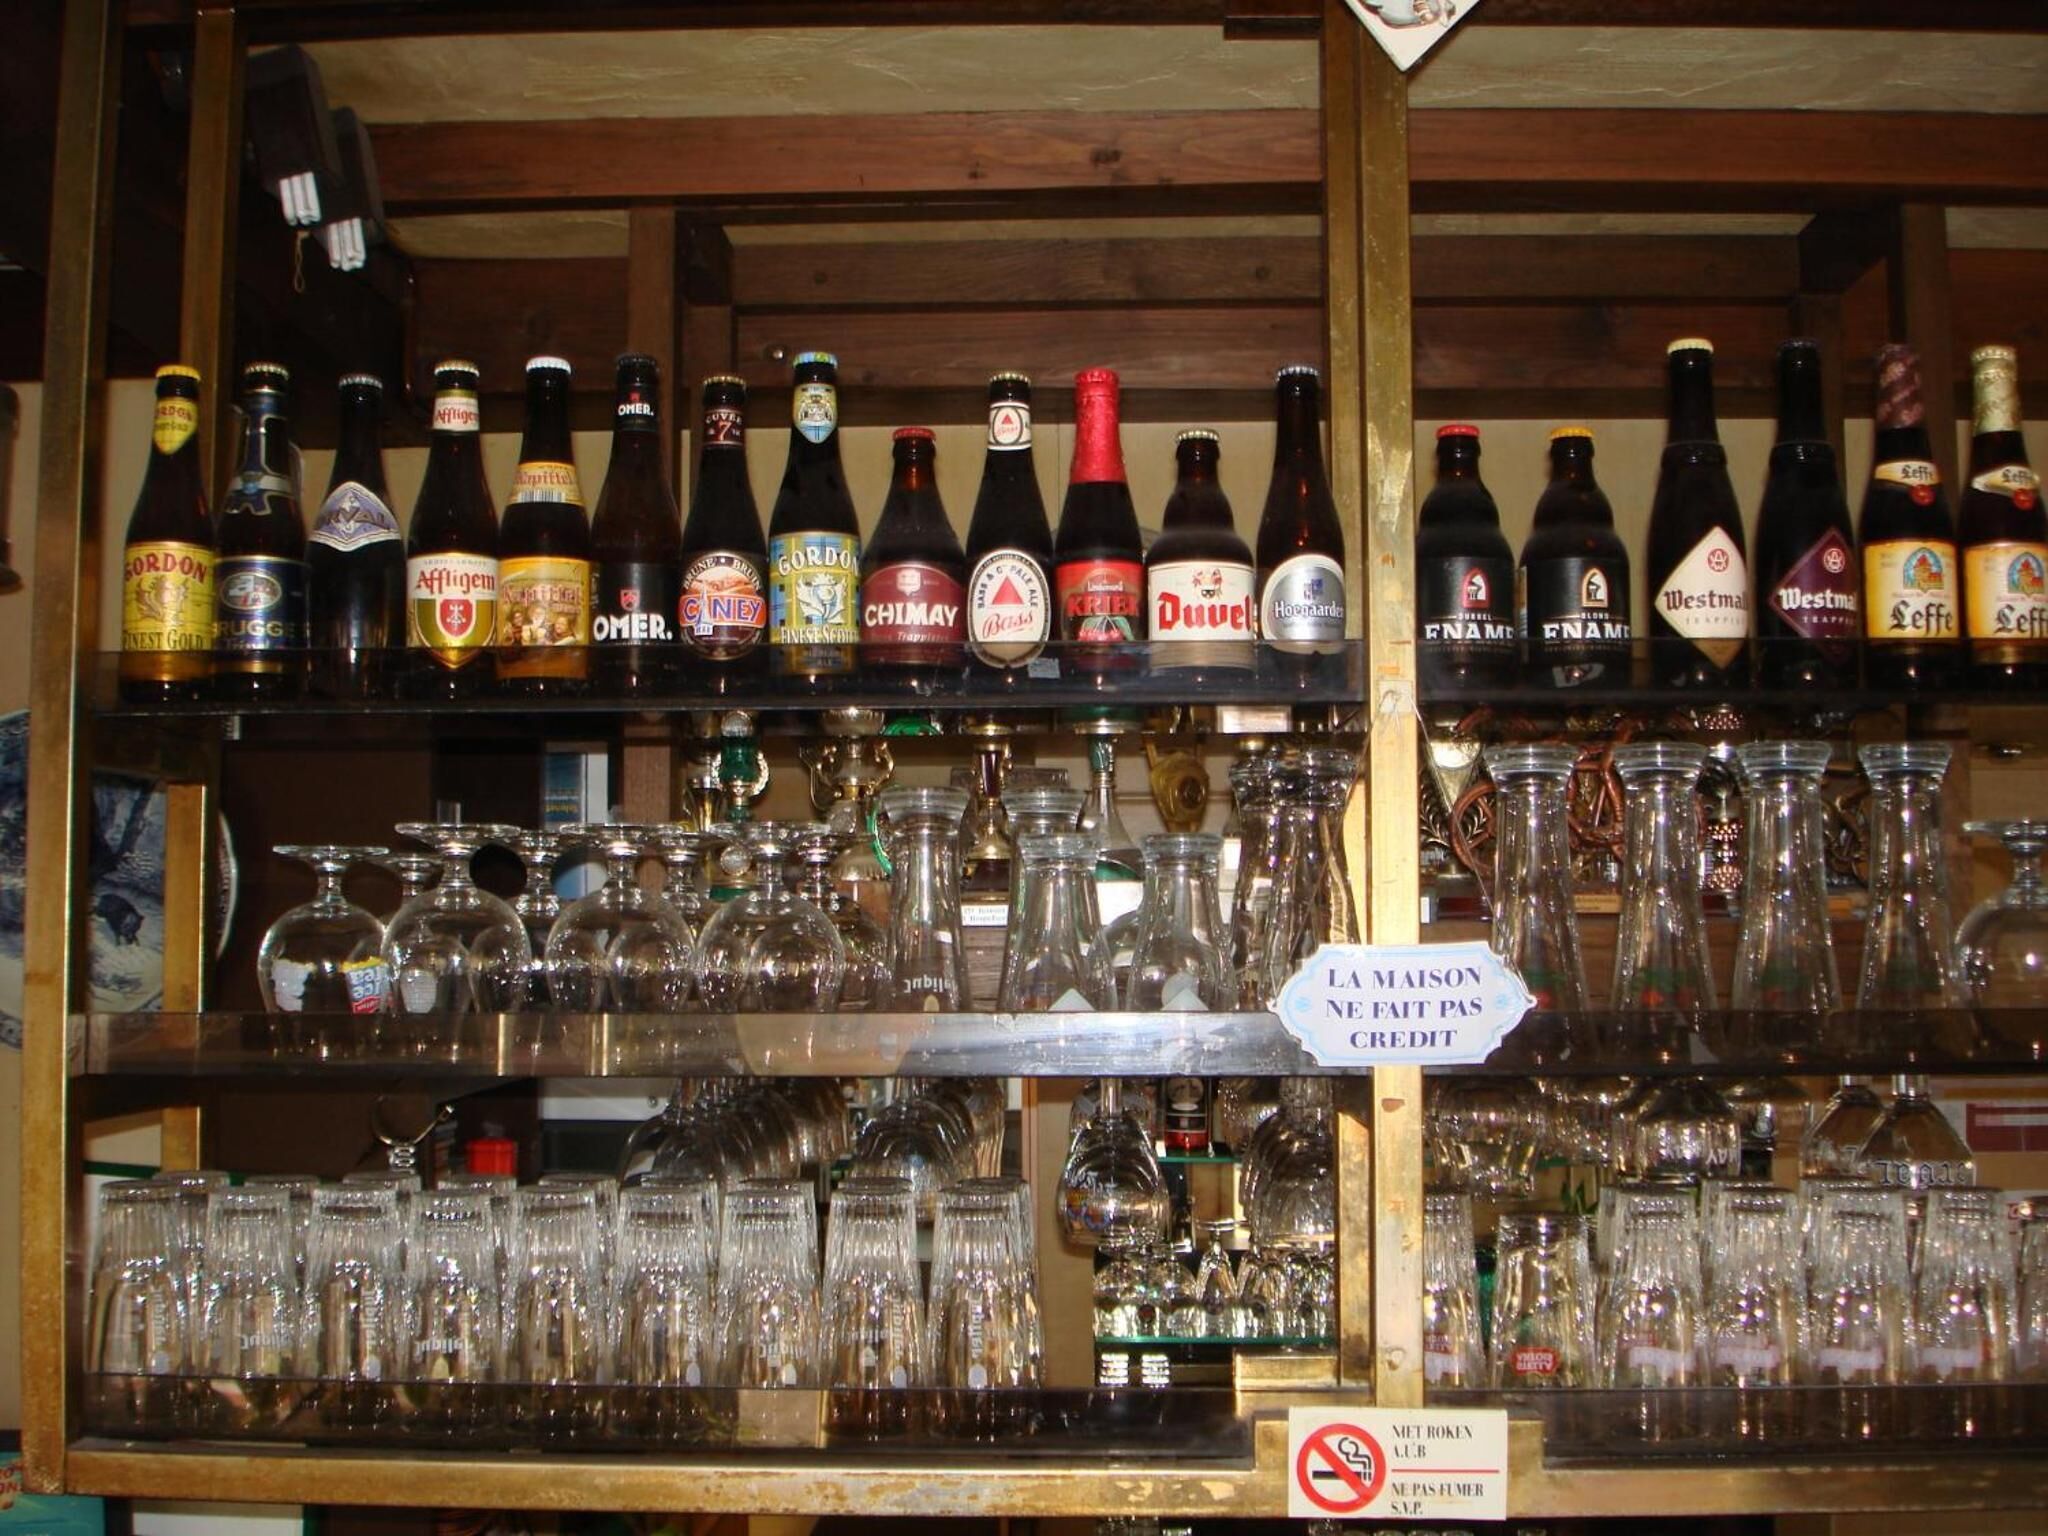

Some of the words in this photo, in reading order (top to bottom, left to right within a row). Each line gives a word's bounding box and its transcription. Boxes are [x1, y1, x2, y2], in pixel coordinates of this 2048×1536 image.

[617, 403, 654, 416] OMER.
[718, 421, 732, 441] 7
[124, 552, 207, 584] GORDON
[416, 568, 497, 595] Affligem
[865, 602, 960, 627] CHIMAY
[1157, 591, 1251, 631] Duvel
[1275, 600, 1345, 619] Hoegaarden
[1888, 600, 1953, 636] Leffe
[594, 613, 673, 641] OMER.
[982, 611, 1034, 640] Bass
[1329, 968, 1361, 989] LA
[1373, 966, 1481, 989] MAISON
[1326, 999, 1363, 1019] NE
[1372, 1000, 1431, 1019] FAIT
[1440, 997, 1483, 1018] PAS
[1350, 1030, 1458, 1049] CREDIT
[1392, 1425, 1423, 1440] NIET
[1427, 1425, 1473, 1440] ROKEN
[1391, 1482, 1411, 1497] NE
[1413, 1483, 1436, 1497] PAS
[1439, 1483, 1484, 1498] FUMER
[1391, 1502, 1423, 1515] S.V.P.
